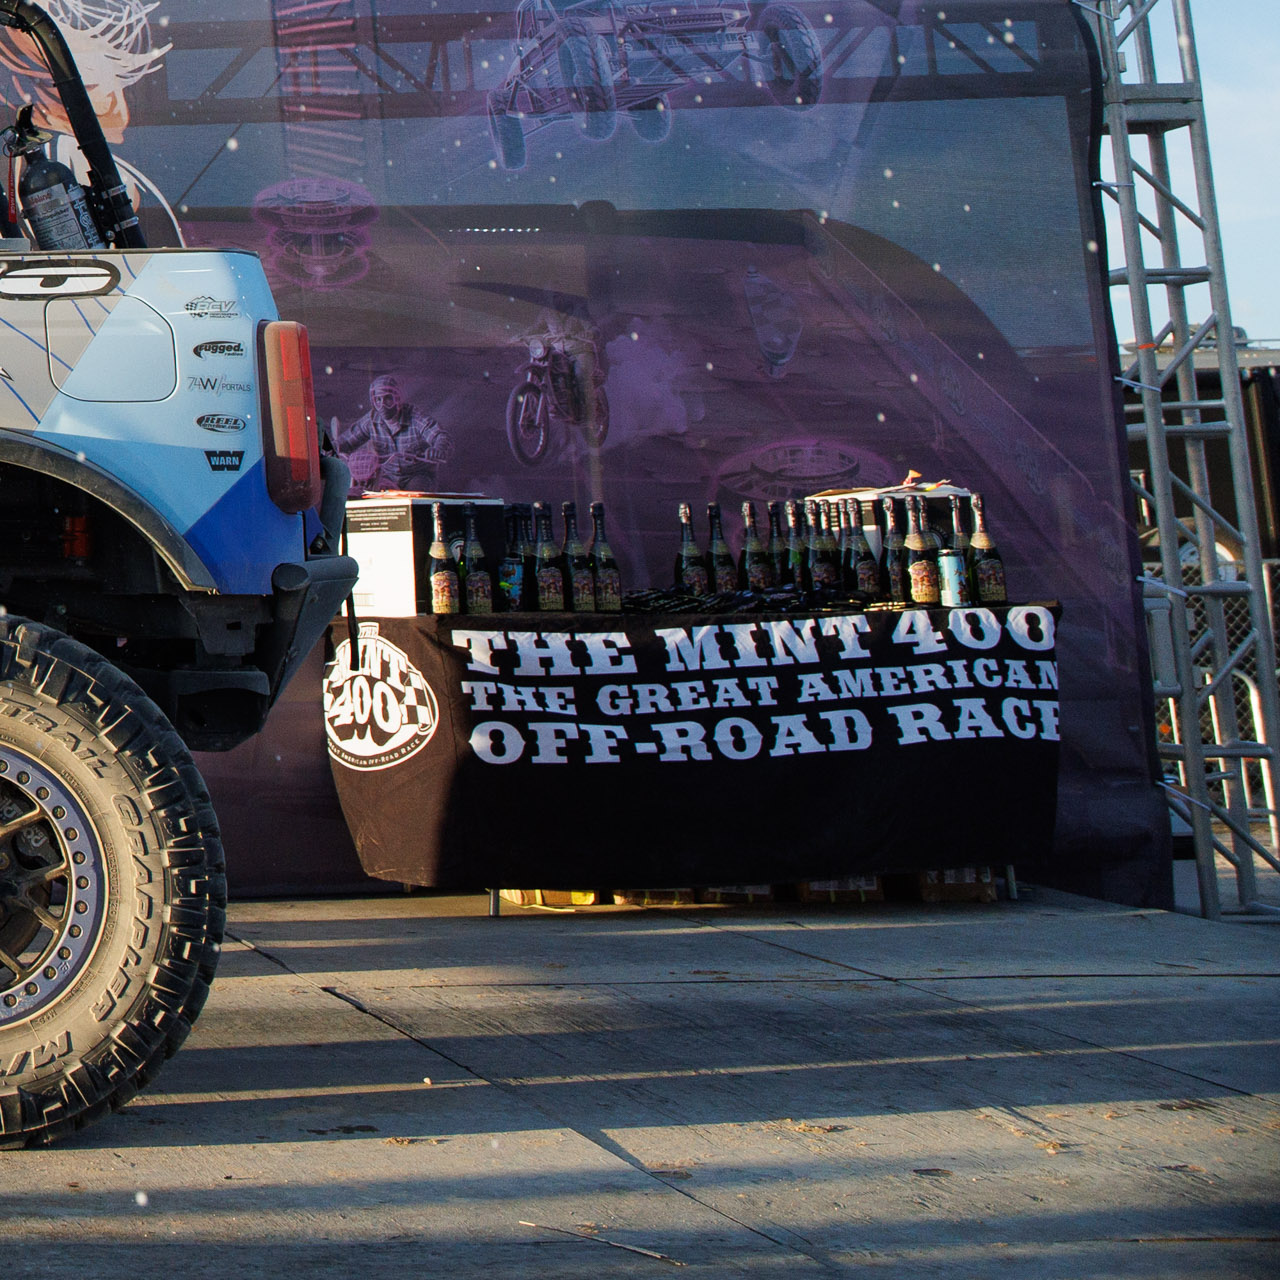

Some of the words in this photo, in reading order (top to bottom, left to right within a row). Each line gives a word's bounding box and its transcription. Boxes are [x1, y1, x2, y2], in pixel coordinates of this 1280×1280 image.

[210, 456, 240, 466] WARN
[452, 628, 639, 676] THE
[655, 614, 873, 673] MINT
[893, 606, 1056, 656] 400
[327, 675, 403, 734] 400
[461, 680, 576, 716] THE
[596, 675, 779, 716] GREAT
[797, 658, 1059, 706] AMERICAN
[469, 706, 875, 765] OFF-ROAD
[89, 793, 153, 1023] GRAPPLER
